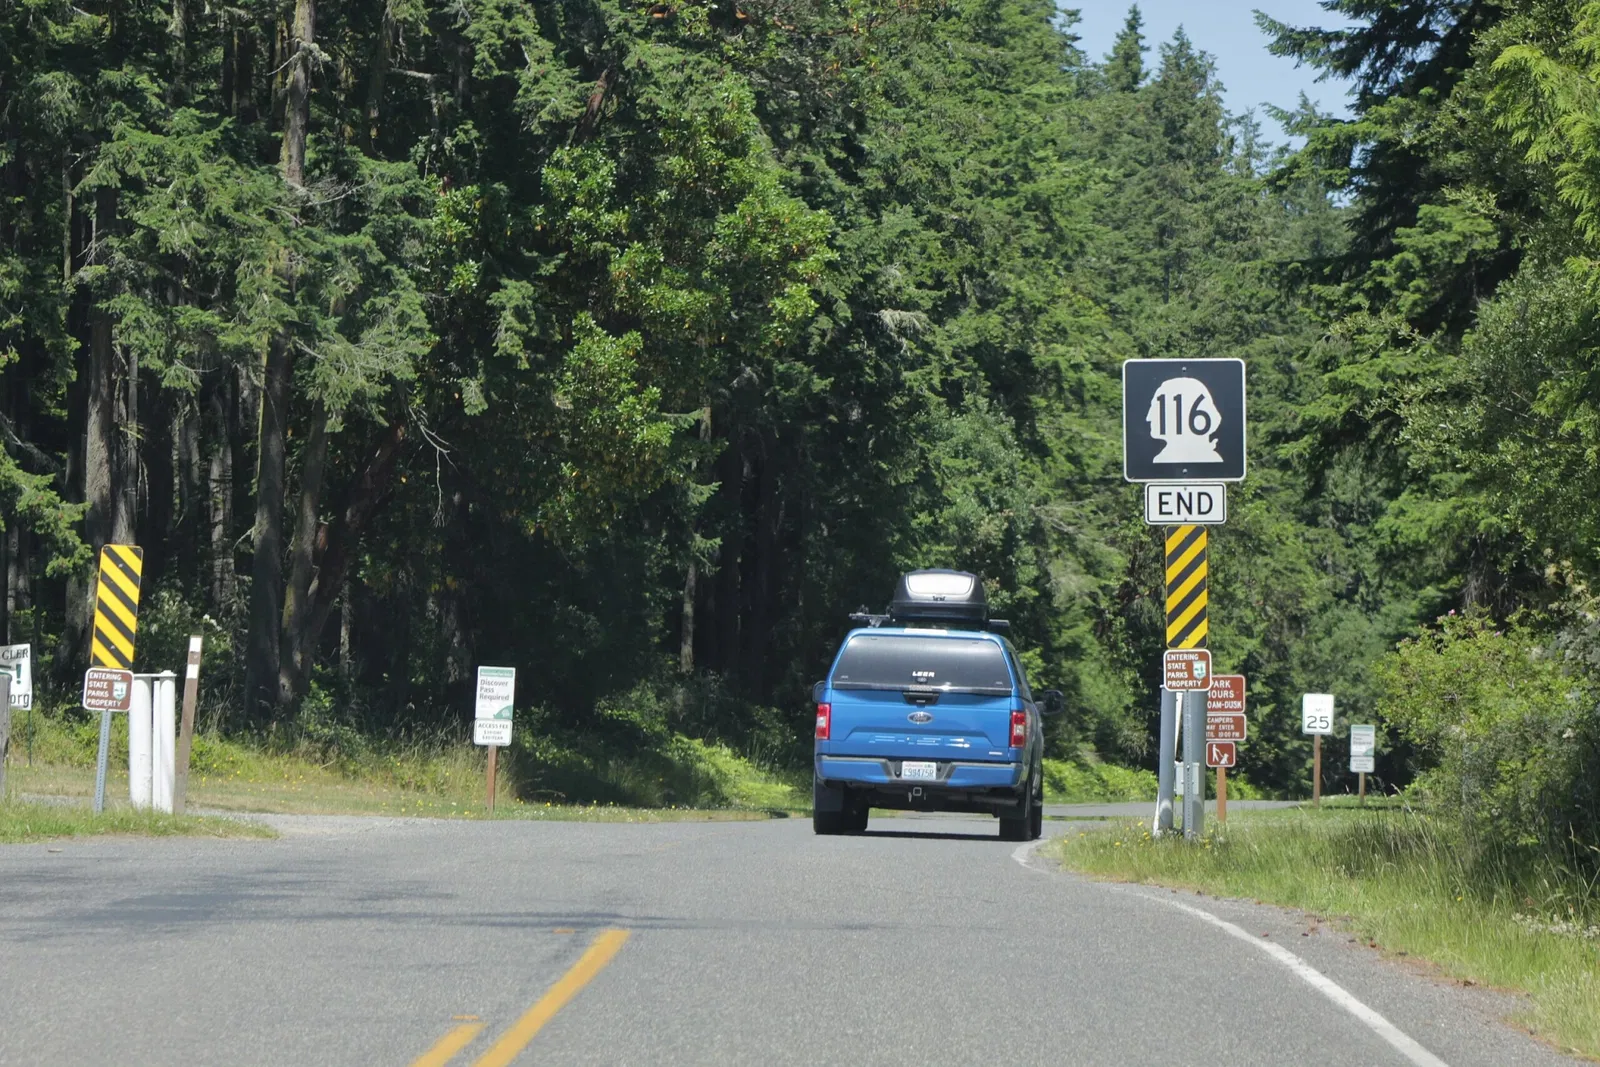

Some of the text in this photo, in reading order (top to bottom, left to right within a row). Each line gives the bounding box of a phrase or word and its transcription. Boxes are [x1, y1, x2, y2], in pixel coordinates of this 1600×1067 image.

[1156, 393, 1212, 436] 116
[1158, 491, 1213, 516] END
[1166, 653, 1199, 661] ENTERING
[1167, 662, 1186, 670] STATE
[89, 671, 122, 681] ENTERING
[911, 670, 936, 678] LEER
[1167, 671, 1188, 679] PARKS
[88, 680, 108, 689] STATE
[480, 678, 509, 687] Discover
[87, 689, 109, 698] PARKS
[479, 693, 510, 702] Required
[86, 698, 122, 707] PROPERTY
[1306, 715, 1330, 730] 25
